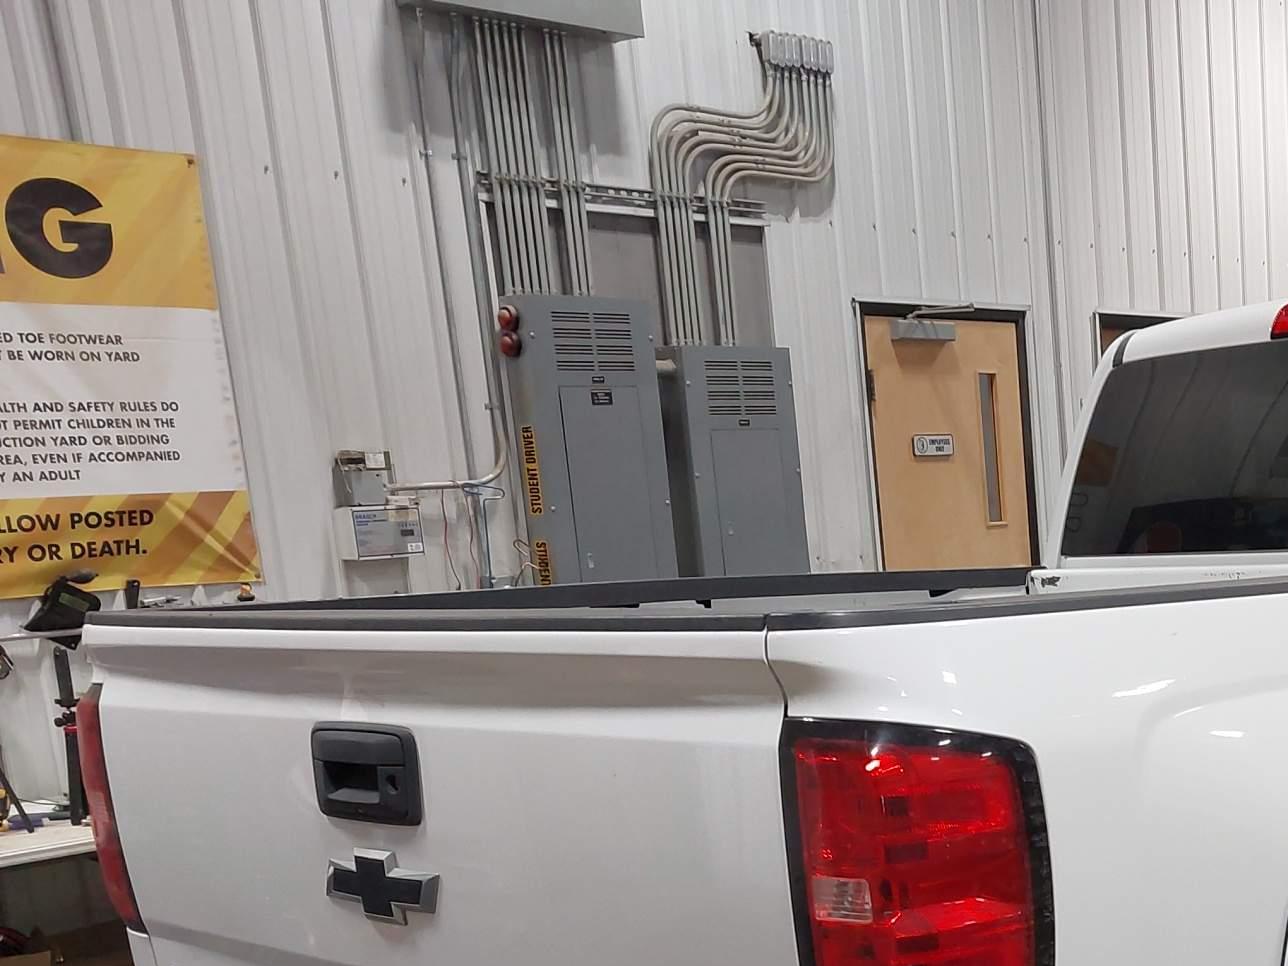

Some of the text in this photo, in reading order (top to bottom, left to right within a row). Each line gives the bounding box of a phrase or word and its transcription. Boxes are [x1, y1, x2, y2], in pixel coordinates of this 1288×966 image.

[0, 177, 113, 279] G
[17, 332, 44, 344] TOE
[50, 333, 123, 345] FOOTWEAR
[7, 350, 24, 361] BE
[28, 350, 75, 362] WORN
[79, 351, 101, 362] ON
[105, 351, 140, 362] YARD
[33, 401, 64, 413] AND
[69, 401, 115, 412] SAFETY
[120, 401, 157, 412] RULES
[161, 401, 179, 412] DO
[0, 417, 175, 430] T PERMIT CHILDREN IN THE
[0, 434, 170, 448] CTION YARD OR BIDDING
[32, 453, 68, 464] EVEN
[72, 452, 83, 464] IF
[88, 450, 181, 462] ACCOMPANIED
[12, 471, 34, 482] AN
[39, 470, 81, 482] ADULT
[521, 425, 542, 514] STUDENT DRIVER
[70, 509, 154, 529] POSTED
[0, 538, 148, 563] Y OR DEATH.
